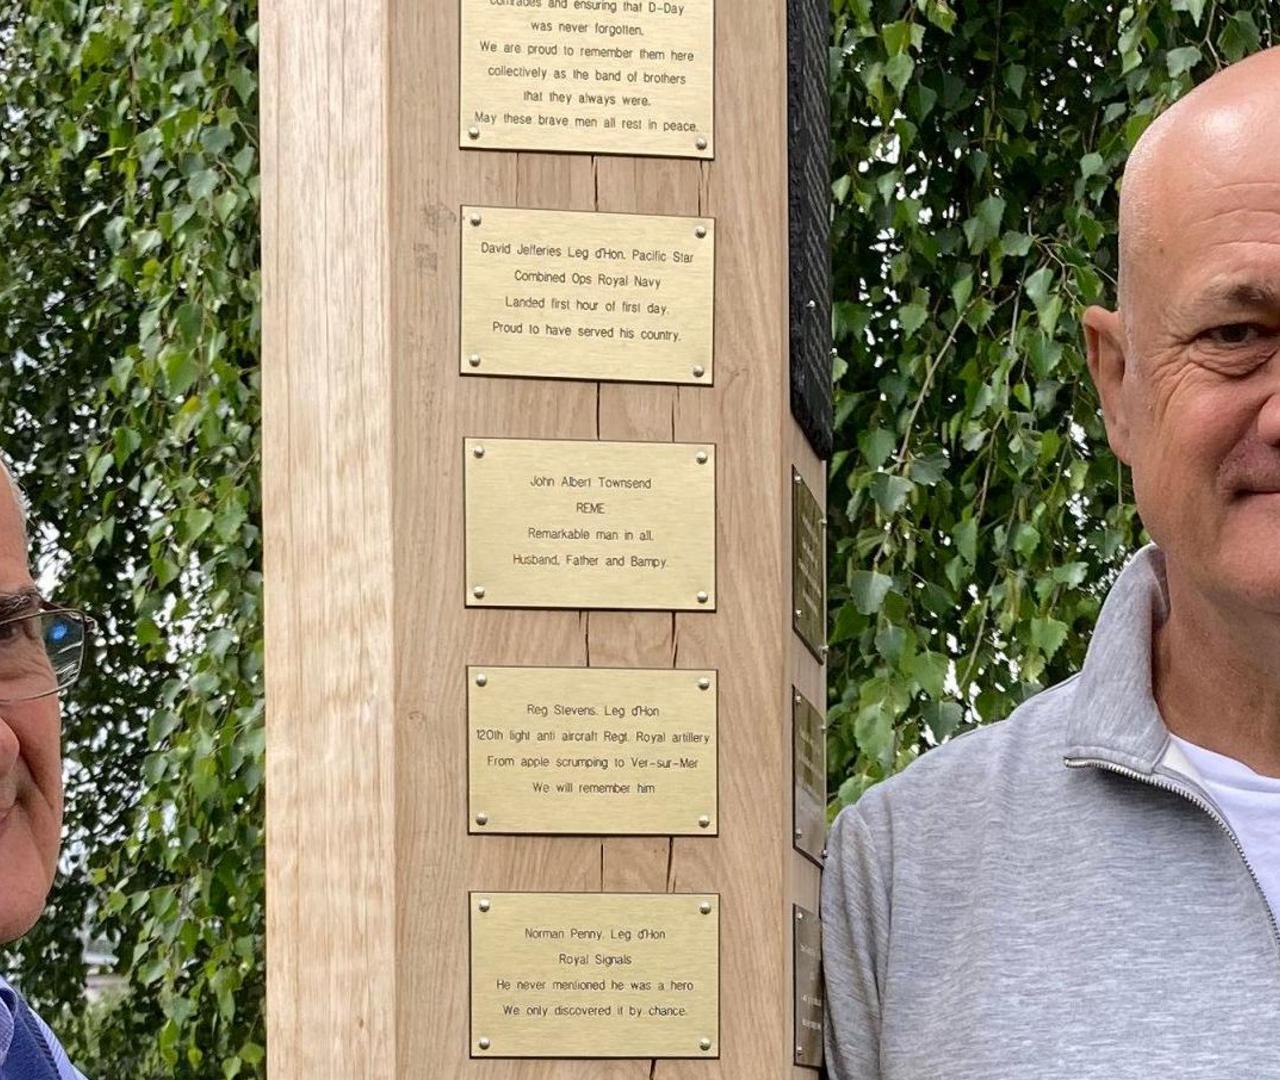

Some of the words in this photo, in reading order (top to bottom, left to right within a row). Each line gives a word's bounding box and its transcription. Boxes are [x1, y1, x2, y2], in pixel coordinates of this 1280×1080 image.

[548, 0, 567, 9] and
[574, 0, 617, 13] ensuring
[624, 1, 642, 12] that
[649, 2, 684, 15] D-Day
[531, 22, 552, 31] was
[559, 24, 588, 33] never
[595, 23, 644, 36] forgotten.
[480, 41, 497, 51] We
[504, 43, 521, 53] are
[528, 45, 557, 55] proud
[564, 46, 573, 56] to
[580, 47, 633, 59] remember
[640, 49, 664, 60] them
[671, 50, 694, 61] here
[488, 66, 547, 79] collectively
[554, 70, 566, 79] as
[573, 69, 589, 80] the
[595, 69, 620, 81] band
[627, 71, 638, 82] of
[644, 72, 686, 84] brothers
[524, 91, 543, 101] that
[549, 91, 572, 104] they
[579, 93, 616, 105] always
[622, 96, 651, 106] were.
[475, 111, 497, 124] May
[504, 113, 532, 124] these
[538, 114, 568, 126] brave
[575, 118, 597, 127] men
[604, 117, 616, 128] all
[622, 119, 641, 129] rest
[648, 119, 657, 130] in
[481, 242, 510, 254] David
[517, 244, 561, 256] Jefferies
[568, 247, 589, 260] Leg
[632, 249, 666, 261] Pacific
[673, 251, 693, 263] Star
[514, 270, 565, 283] Combined
[572, 272, 592, 285] Ops
[598, 273, 628, 287] Royal
[634, 275, 661, 289] Navy
[505, 296, 544, 308] Landed
[551, 298, 570, 309] first
[576, 300, 598, 311] hour
[605, 301, 615, 311] of
[622, 301, 640, 312] first
[493, 322, 522, 333] Proud
[529, 324, 539, 334] to
[546, 324, 571, 335] have
[578, 326, 613, 337] served
[620, 327, 634, 338] his
[530, 476, 554, 486] John
[561, 476, 591, 487] Albert
[598, 477, 652, 489] Townsend
[576, 503, 605, 514] REME
[528, 528, 590, 539] Remarkable
[596, 531, 618, 540] man
[625, 530, 633, 540] in
[566, 555, 598, 566] Father
[605, 556, 625, 566] and
[527, 704, 548, 716] Reg
[604, 705, 625, 718] Leg
[510, 730, 530, 742] light
[537, 731, 555, 741] anti
[562, 731, 597, 741] aircraft
[636, 732, 666, 744] Royal
[672, 733, 710, 744] artillery
[487, 756, 515, 766] From
[521, 757, 550, 768] apple
[556, 758, 608, 769] scrumping
[615, 758, 624, 768] to
[533, 783, 550, 792] We
[556, 783, 573, 793] will
[579, 784, 630, 793] remember
[637, 783, 655, 793] him
[525, 928, 564, 939] Norman
[611, 930, 631, 941] Leg
[559, 954, 589, 965] Royal
[595, 954, 632, 966] Signals
[496, 980, 511, 990] He
[517, 981, 546, 991] never
[553, 980, 605, 991] mentioned
[611, 980, 624, 991] he
[631, 982, 652, 991] was
[658, 982, 664, 991] a
[503, 1005, 520, 1015] We
[527, 1006, 548, 1017] only
[555, 1005, 611, 1016] discovered
[617, 1005, 623, 1016] it
[629, 1005, 642, 1017] by
